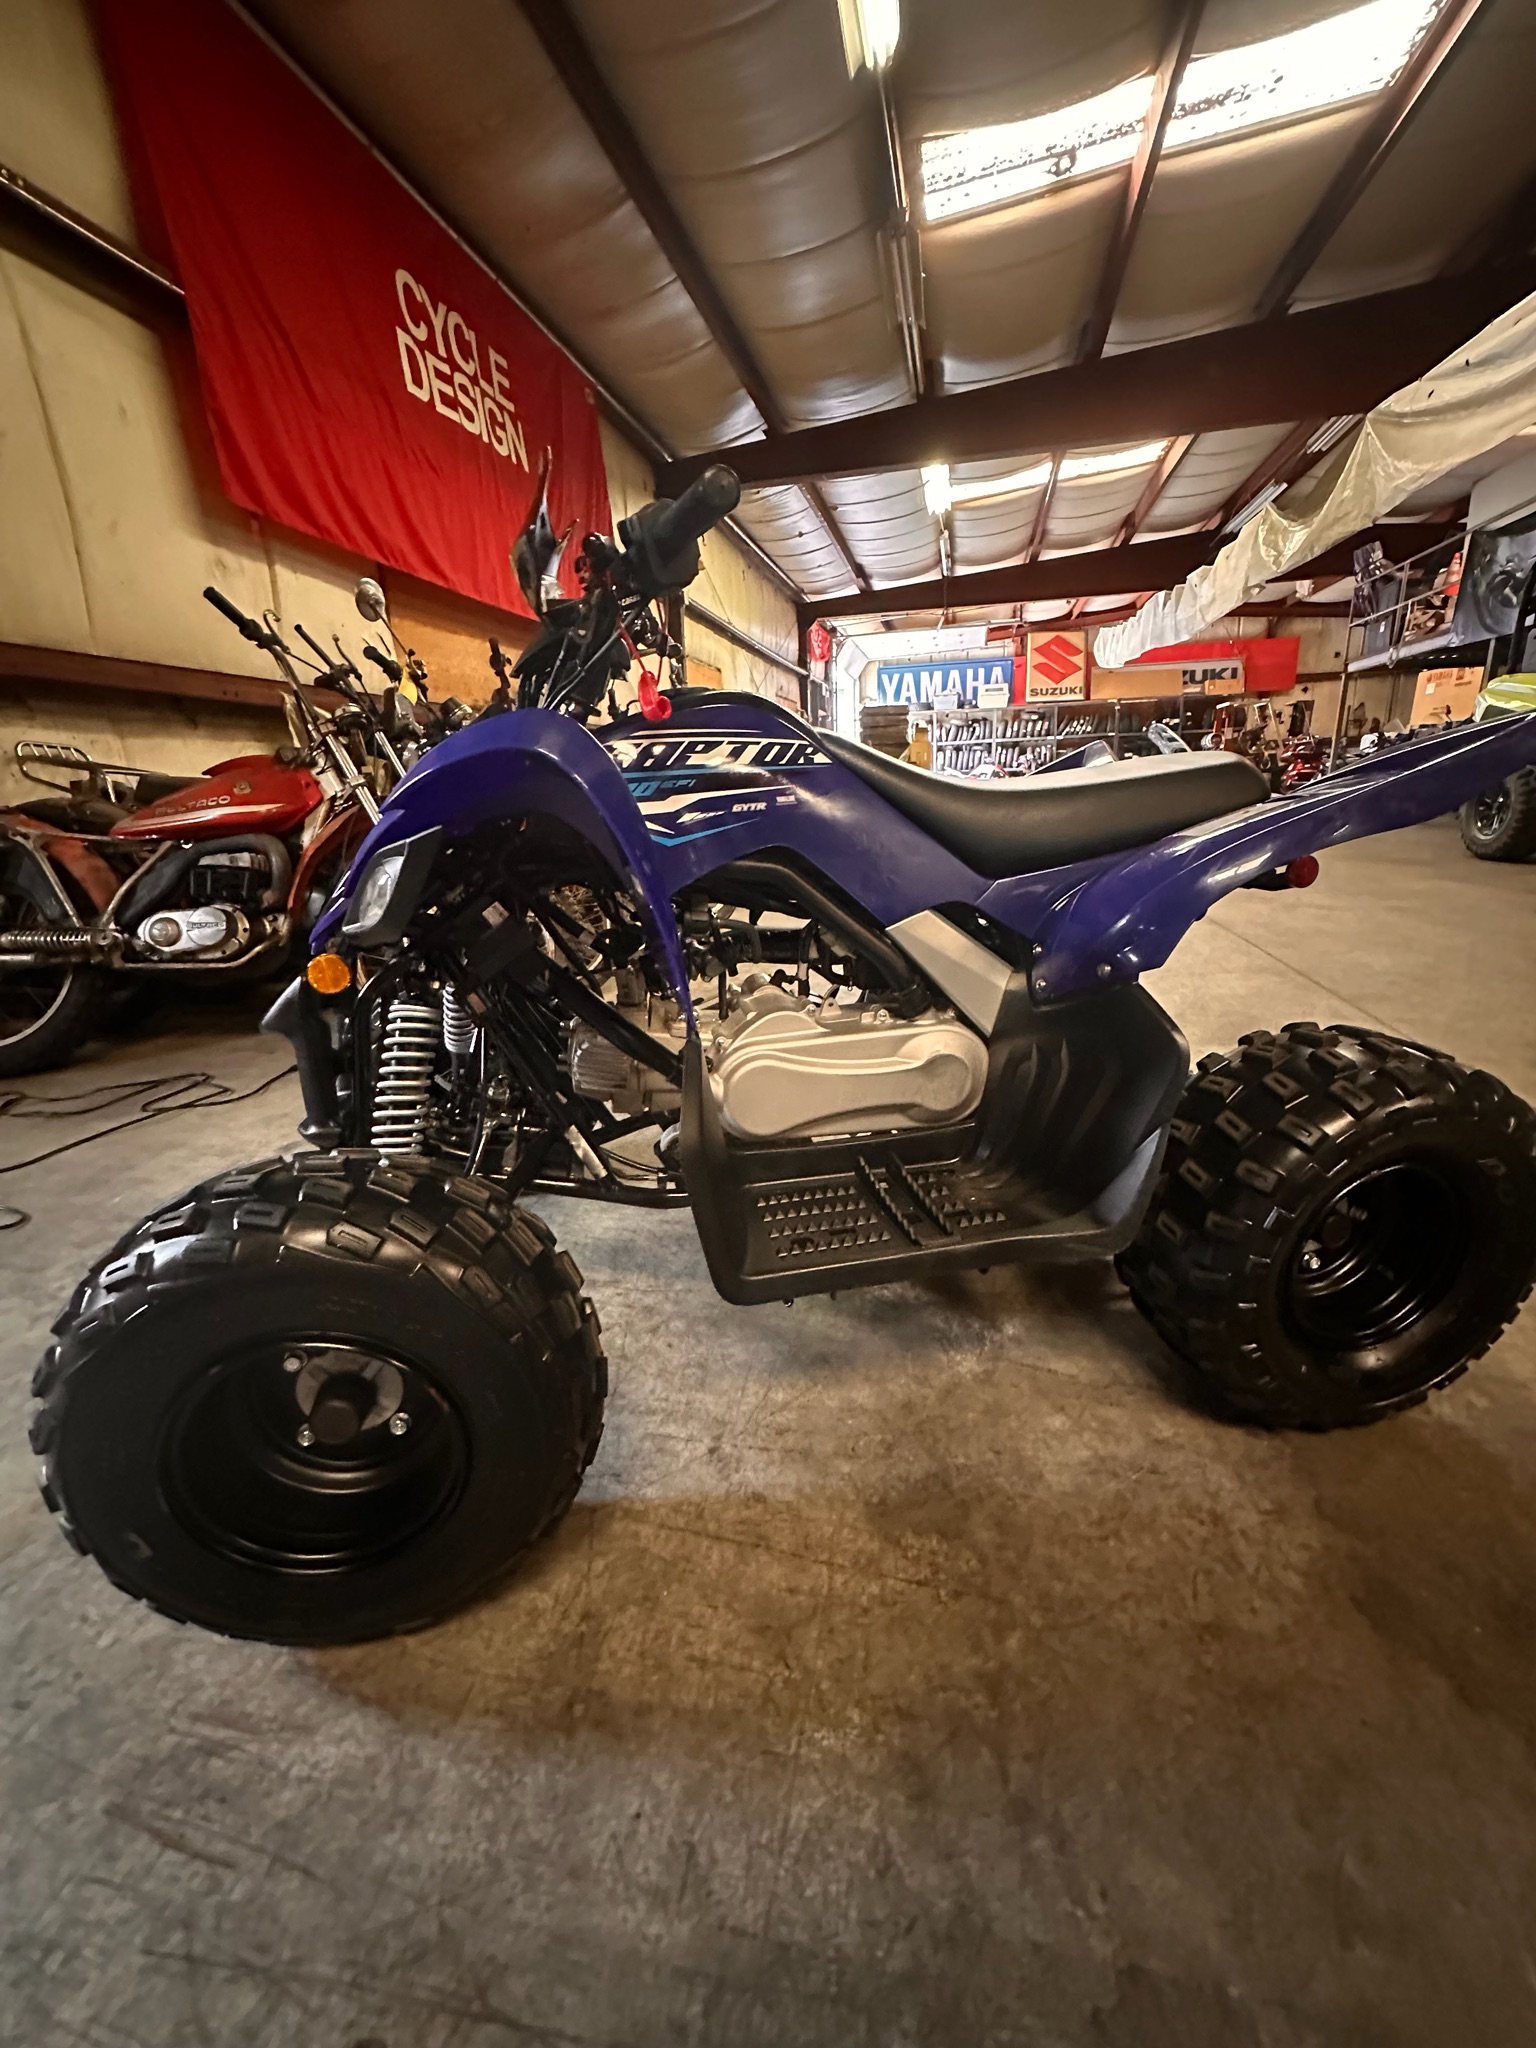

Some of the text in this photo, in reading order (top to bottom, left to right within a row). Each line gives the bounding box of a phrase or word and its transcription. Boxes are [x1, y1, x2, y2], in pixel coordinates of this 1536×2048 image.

[395, 268, 515, 413] CYCLE
[395, 325, 529, 474] DESIGN
[1029, 686, 1083, 697] SUZUKI
[731, 801, 768, 813] GYTR
